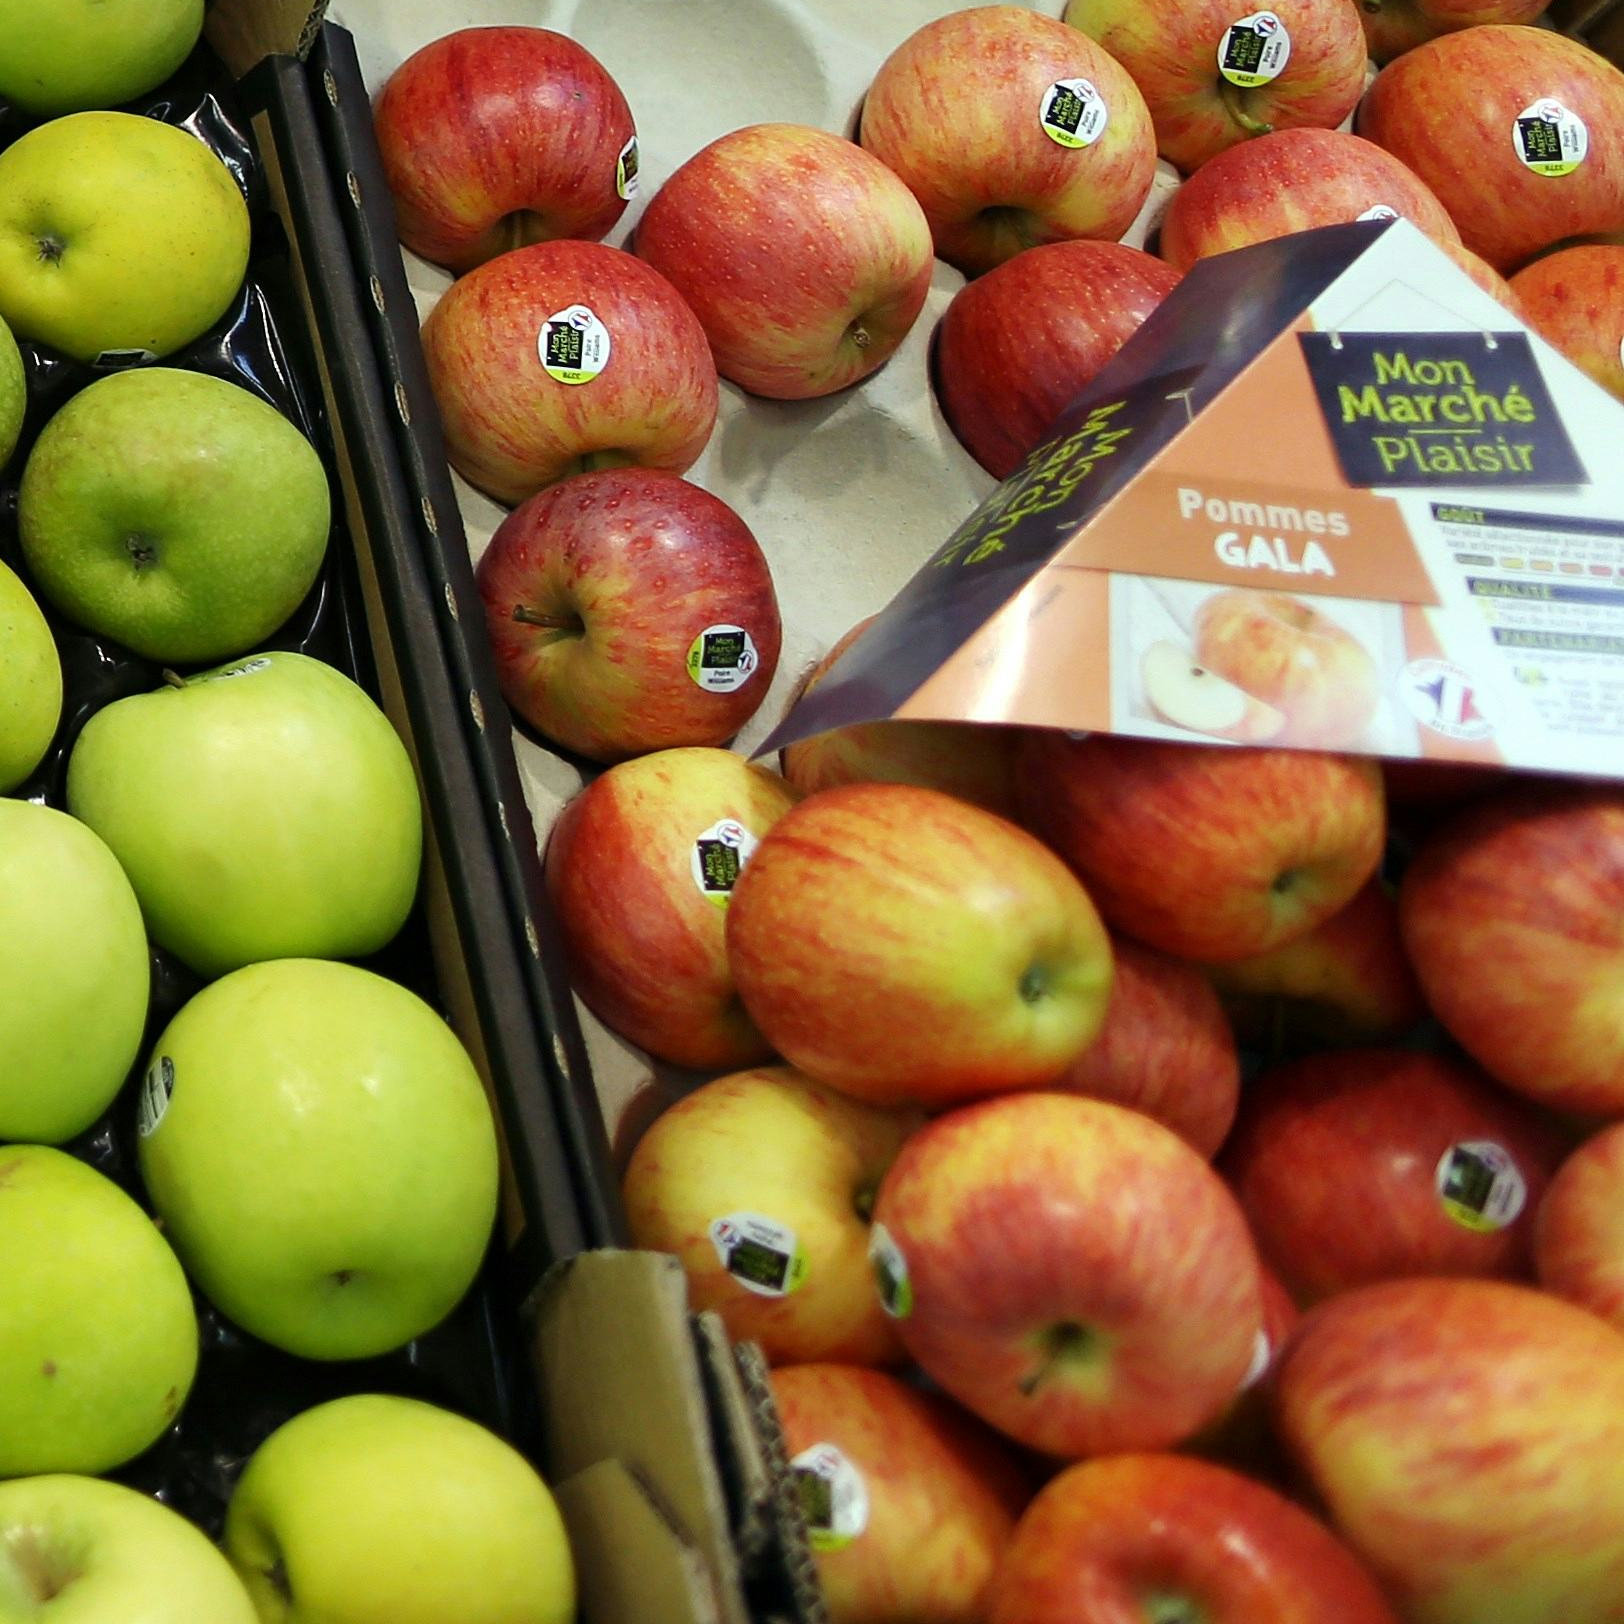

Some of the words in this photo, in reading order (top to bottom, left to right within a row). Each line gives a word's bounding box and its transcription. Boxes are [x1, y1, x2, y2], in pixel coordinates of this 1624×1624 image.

[1534, 121, 1546, 157] Marché
[1571, 125, 1579, 153] Williams
[1372, 352, 1474, 385] Mon
[1337, 384, 1536, 423] Marché
[1035, 428, 1133, 511] Mon
[1371, 436, 1535, 472] Plaisir
[963, 401, 1126, 566] Marché
[1178, 487, 1350, 536] Pommes
[1213, 532, 1336, 579] GALA
